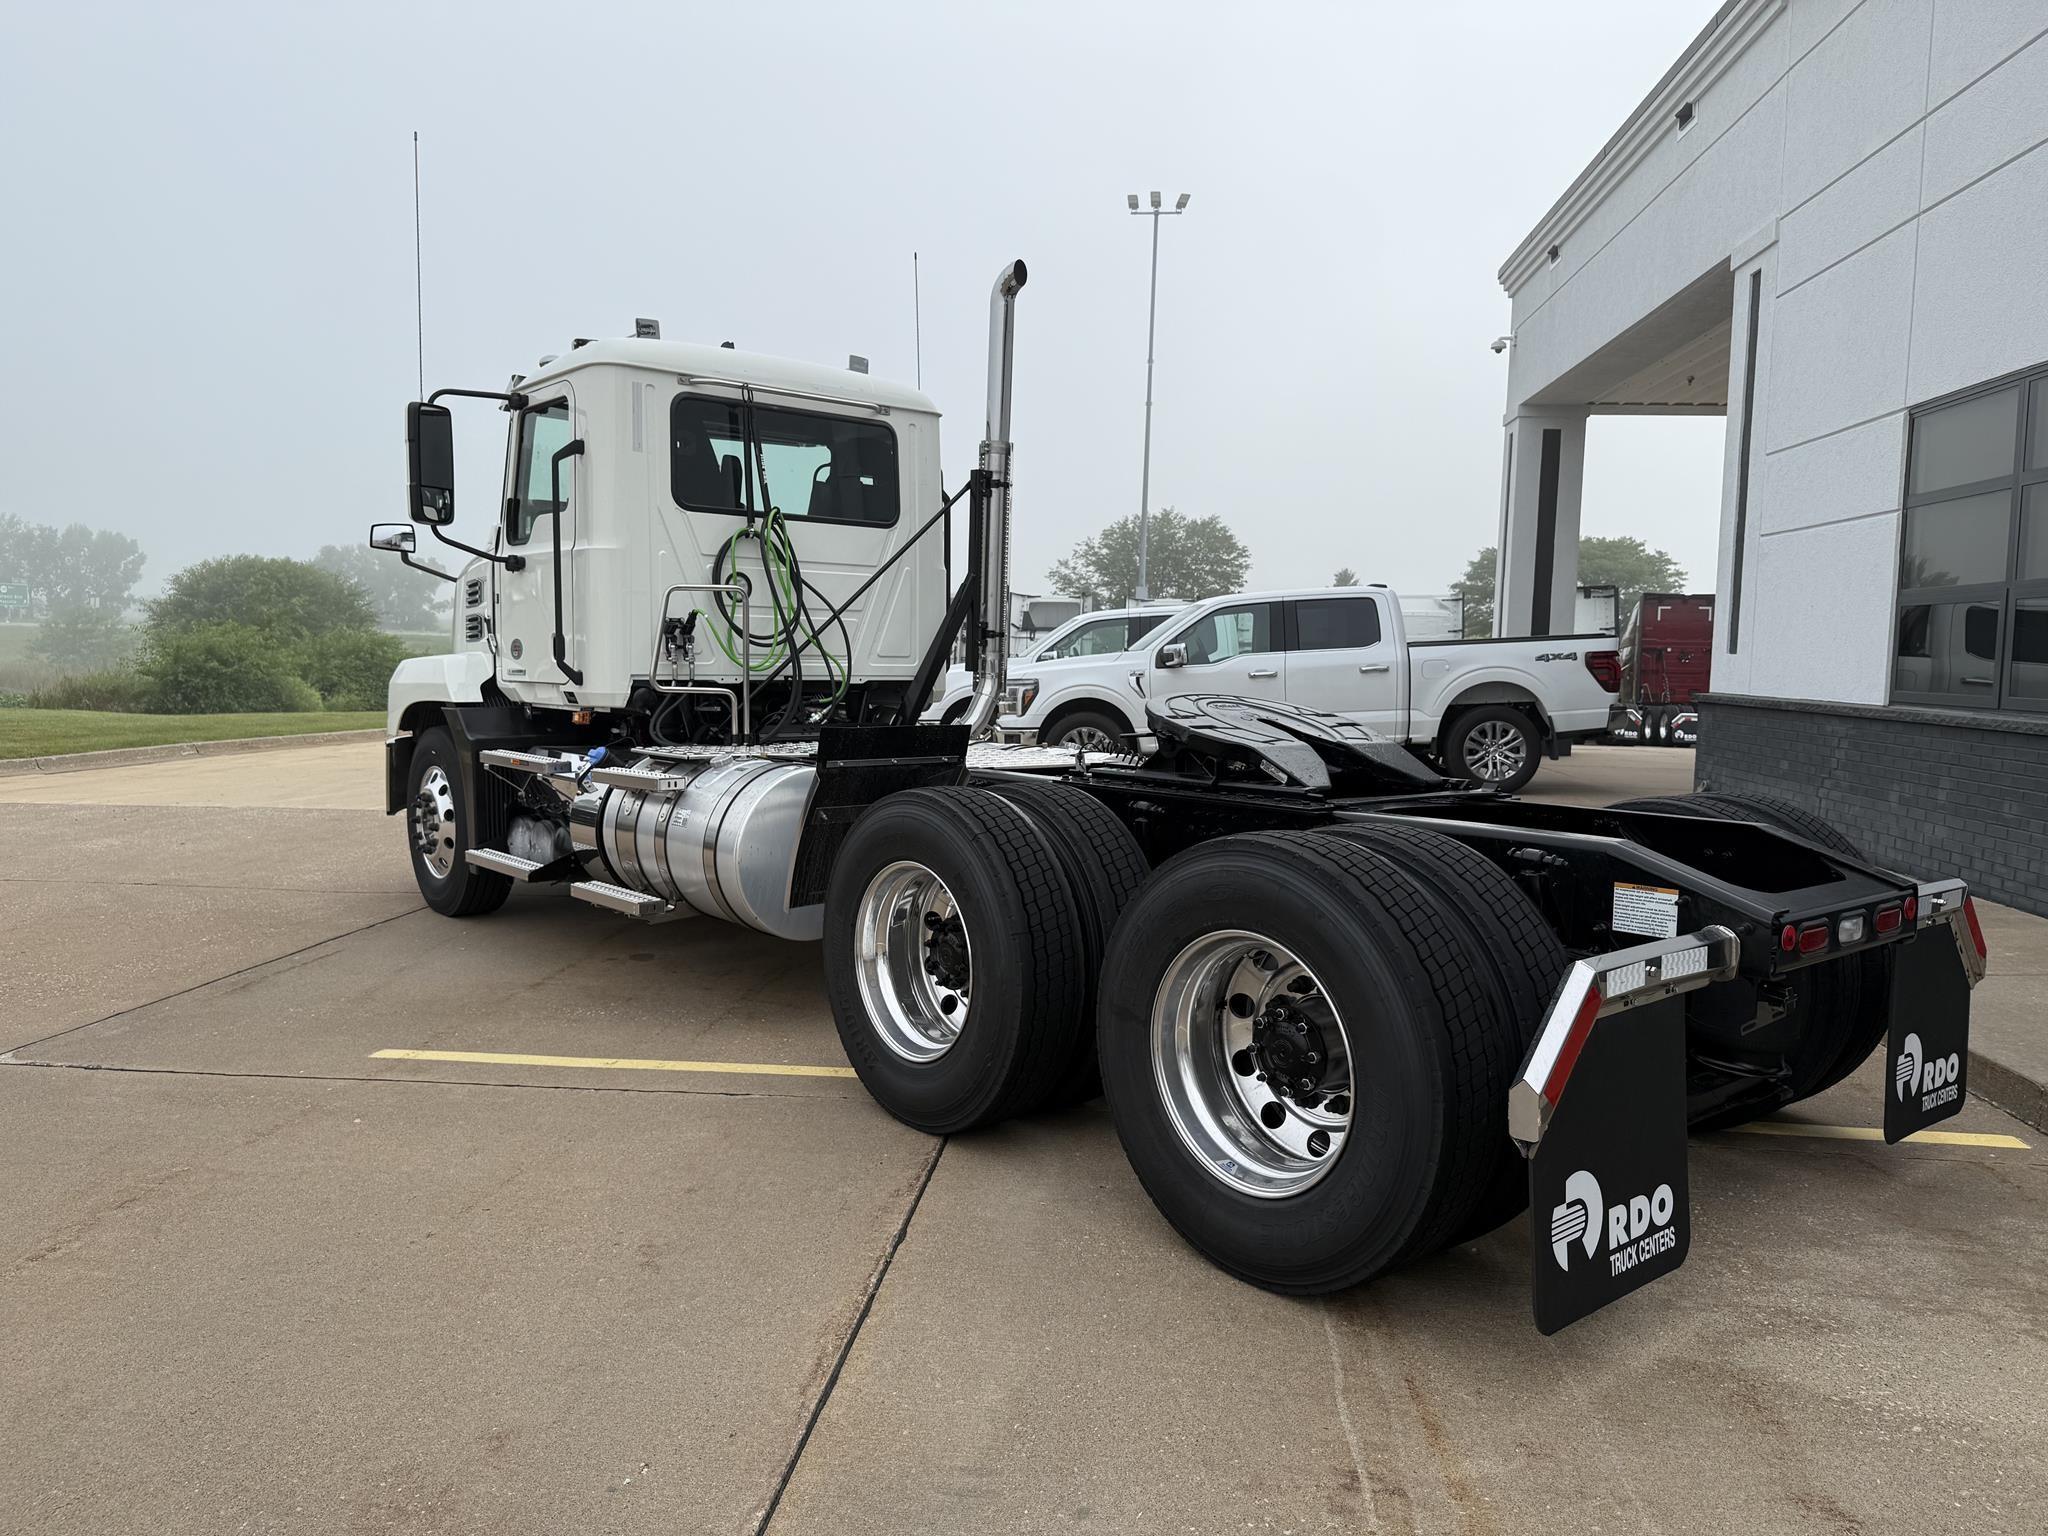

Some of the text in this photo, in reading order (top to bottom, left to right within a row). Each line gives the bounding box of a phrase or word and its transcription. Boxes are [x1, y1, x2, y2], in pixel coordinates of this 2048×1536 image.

[1923, 1052, 1959, 1093] RDO
[1922, 1084, 1958, 1112] TRUCK CENTERS
[1608, 1183, 1674, 1251] RDO
[1610, 1226, 1676, 1277] TRUCK CENTERS
